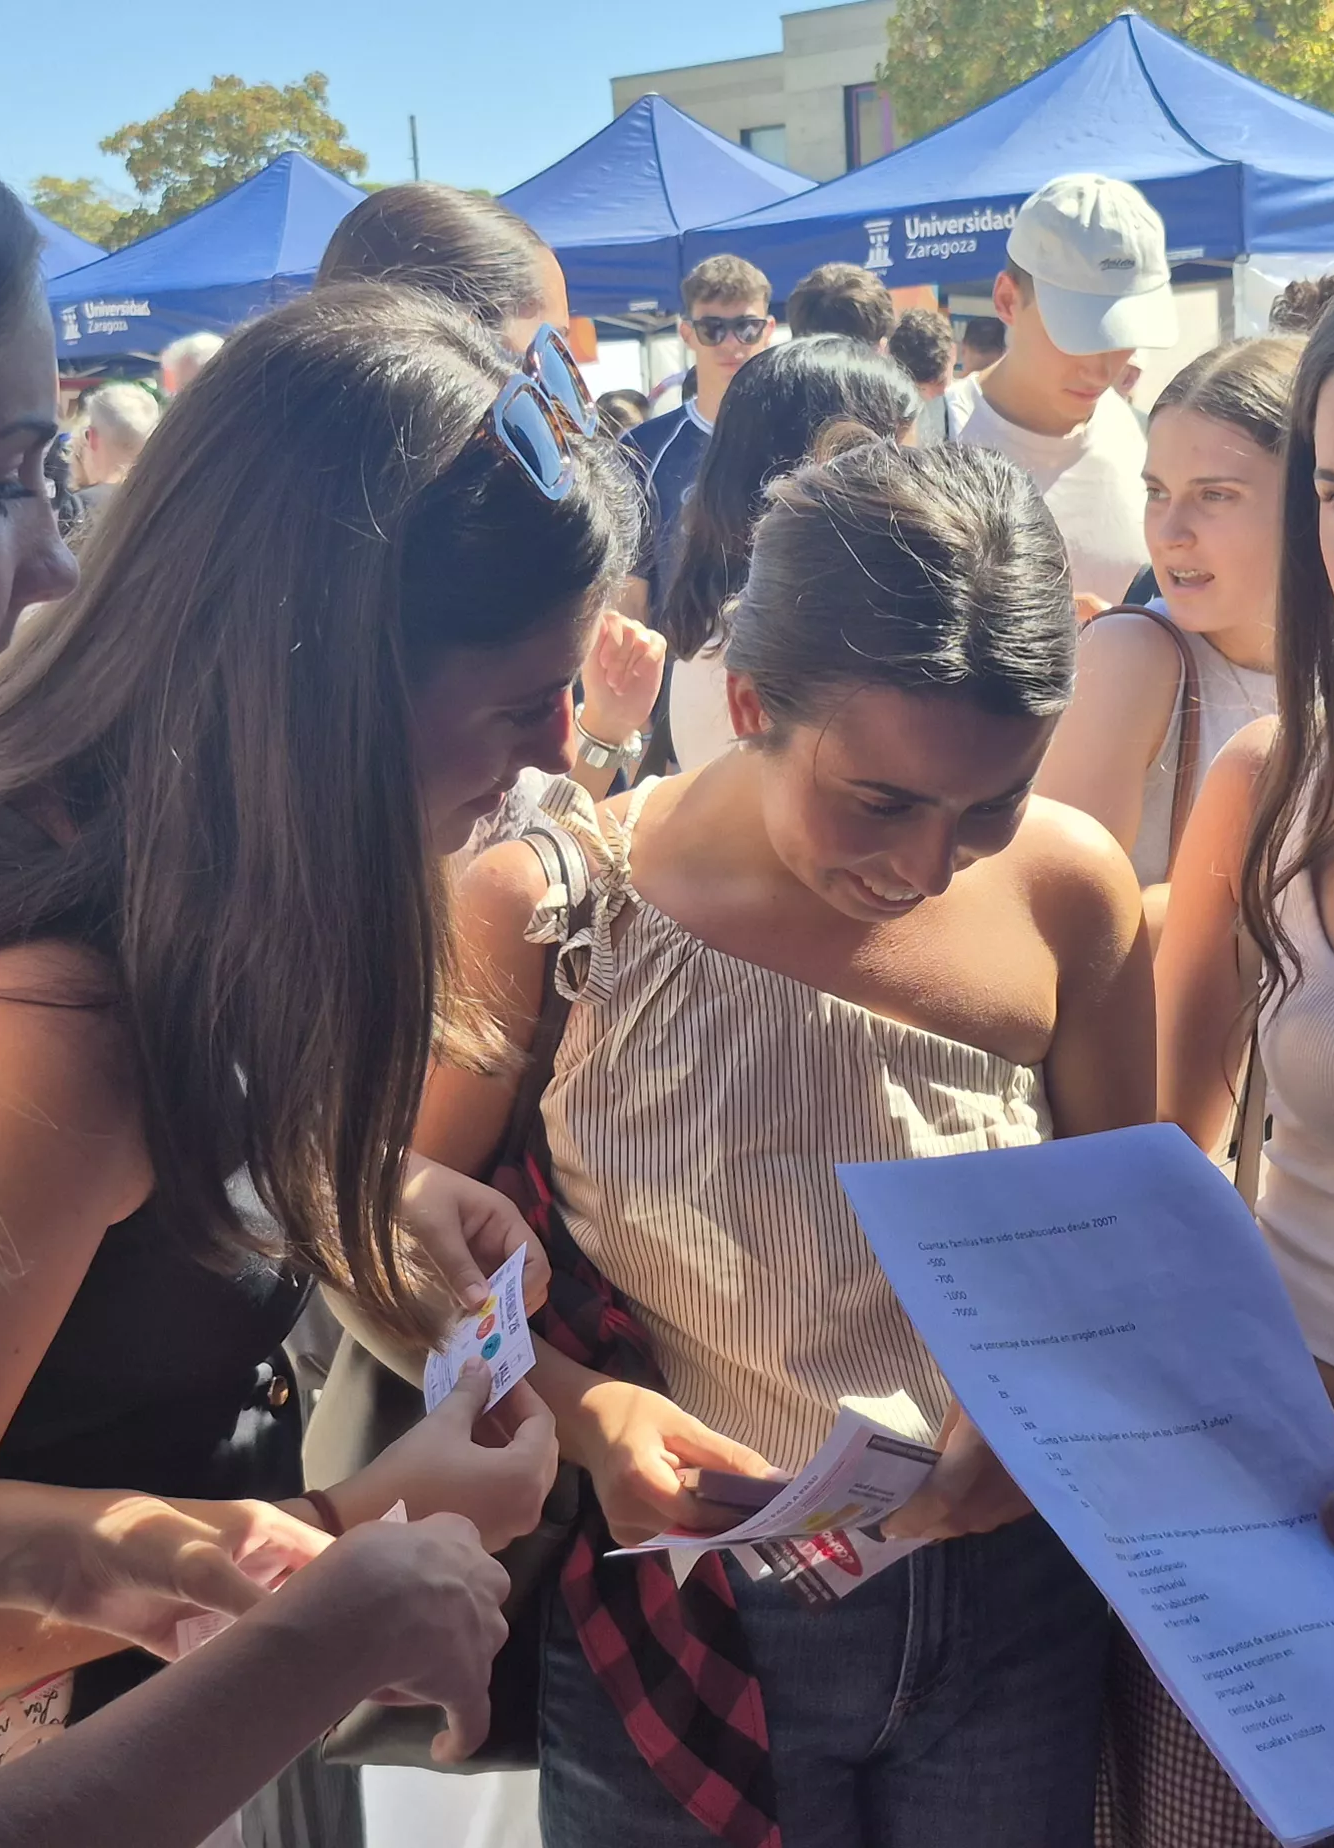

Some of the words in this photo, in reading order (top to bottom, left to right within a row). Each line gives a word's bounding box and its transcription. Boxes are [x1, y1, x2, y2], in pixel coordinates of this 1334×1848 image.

[905, 206, 1017, 239] Universidad
[905, 238, 978, 260] Zaragoza
[85, 298, 151, 319] Universidad
[87, 320, 129, 335] Zaragoza
[980, 1235, 995, 1245] han
[996, 1232, 1013, 1243] sido
[1014, 1224, 1066, 1240] desahuciadas
[1067, 1221, 1091, 1233] desde
[1092, 1215, 1117, 1228] 2007?
[927, 1257, 946, 1268] -500
[935, 1273, 954, 1284] -700
[1021, 1338, 1030, 1347] de
[1060, 1334, 1070, 1343] en
[1098, 1325, 1115, 1337] está
[1201, 1419, 1208, 1430] 3
[1210, 1413, 1233, 1428] años?
[1227, 1641, 1254, 1656] puntos
[1254, 1636, 1264, 1646] de
[1255, 1699, 1266, 1709] de
[1266, 1693, 1286, 1704] salud
